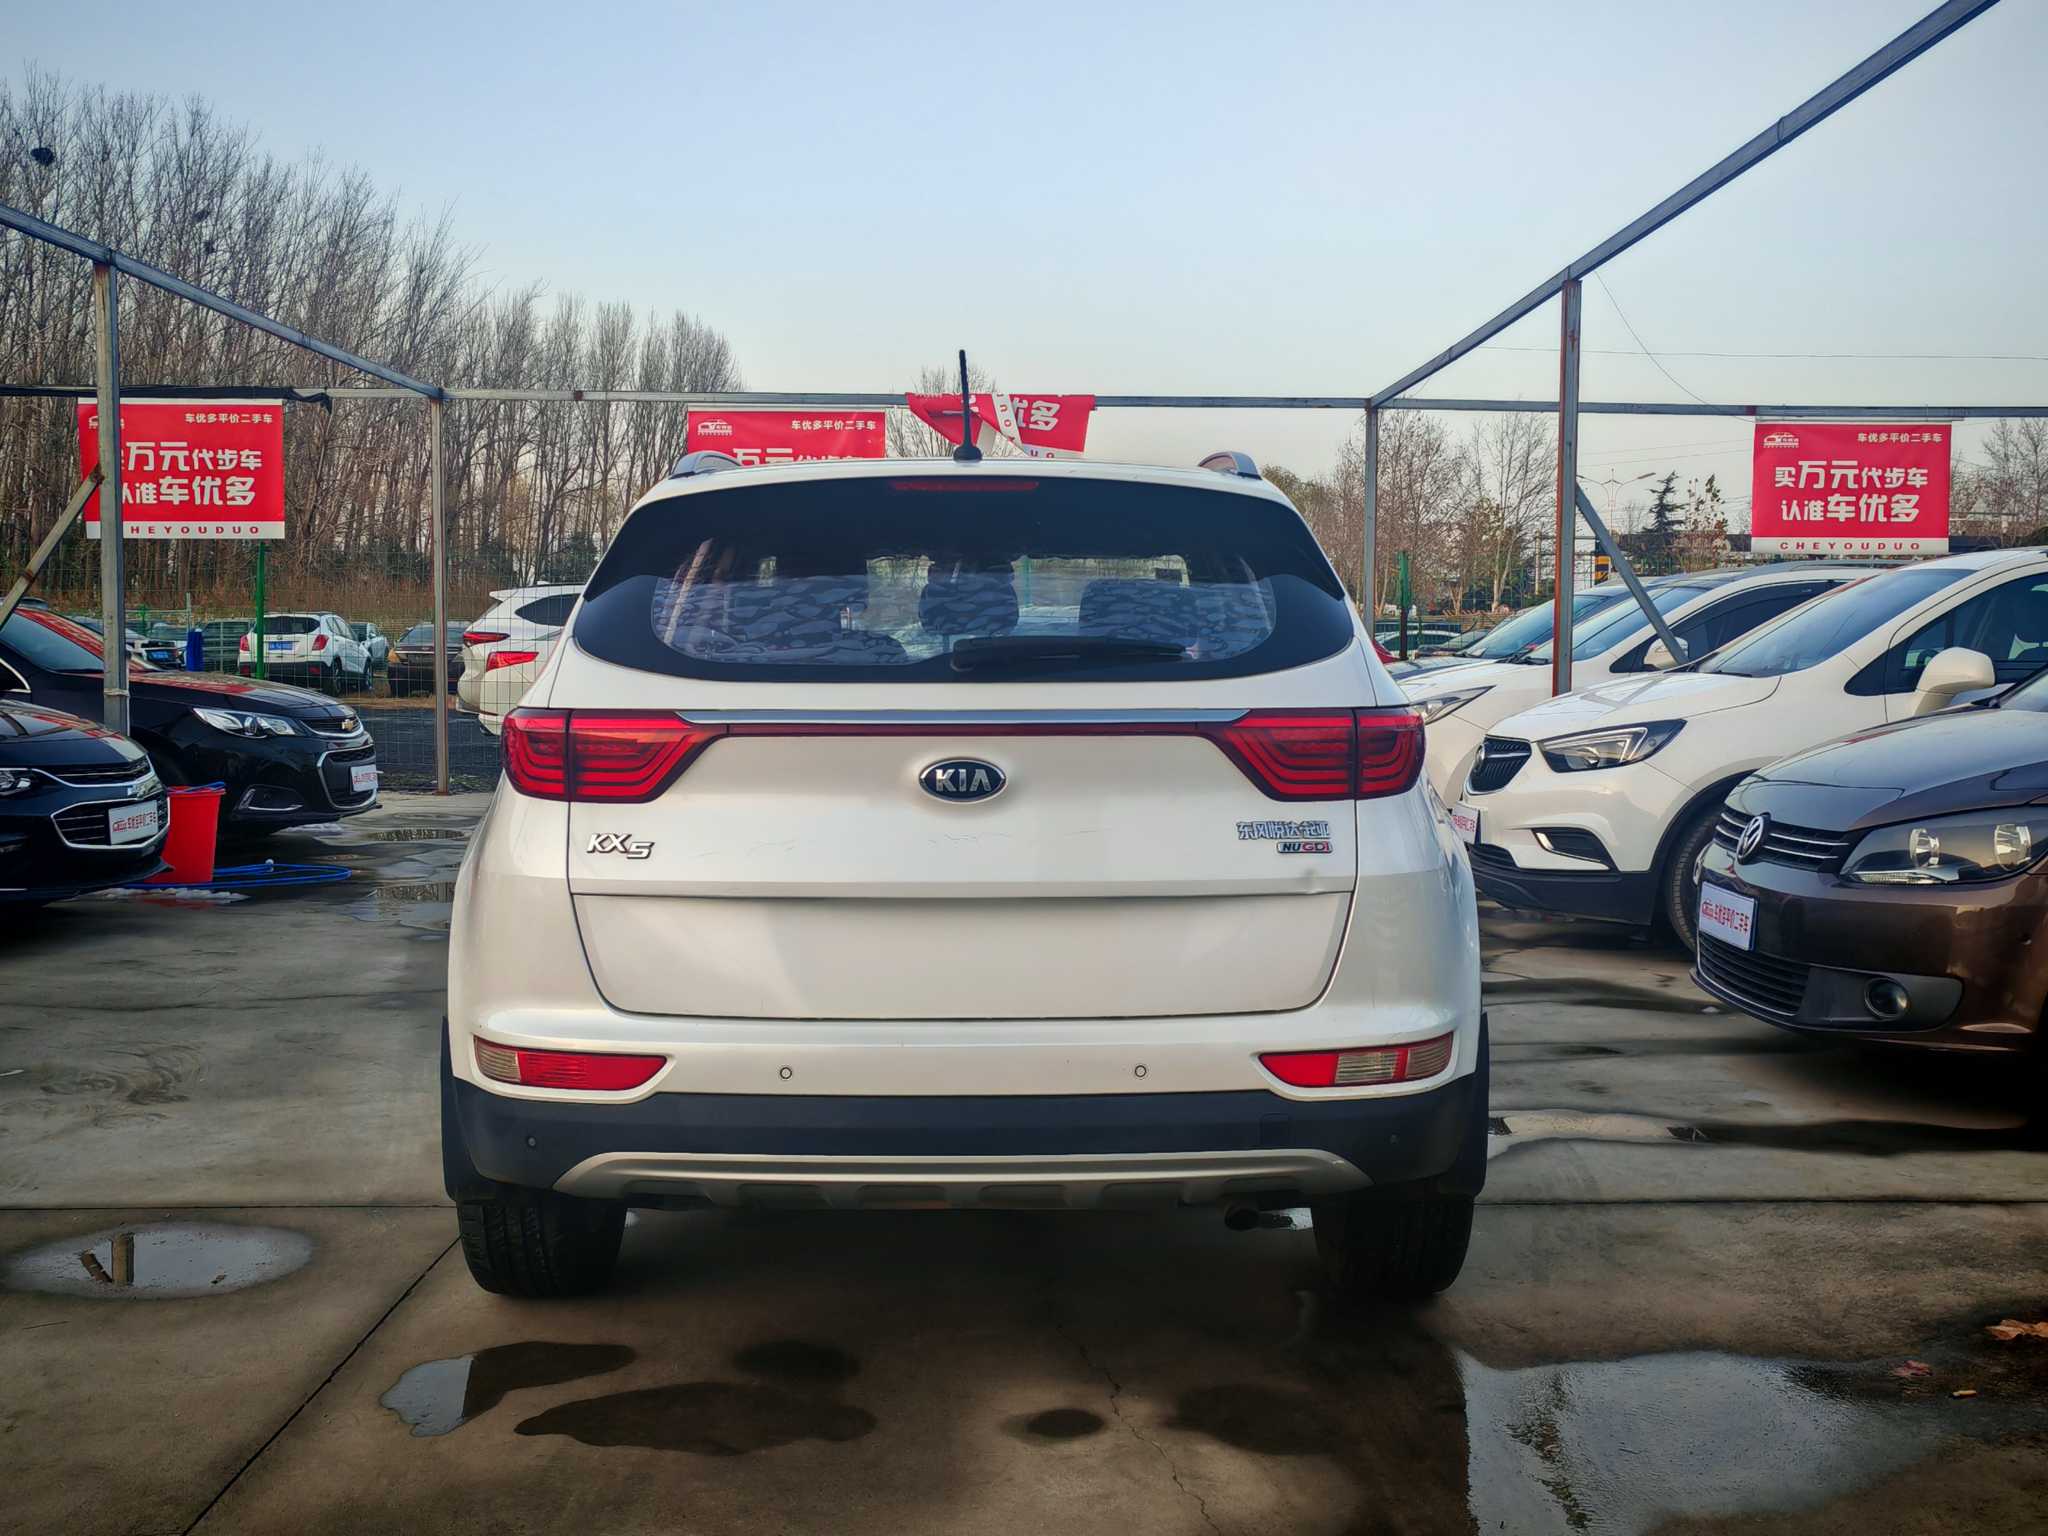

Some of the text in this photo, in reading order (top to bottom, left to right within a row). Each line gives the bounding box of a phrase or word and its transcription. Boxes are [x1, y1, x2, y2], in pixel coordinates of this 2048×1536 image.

[185, 413, 273, 424] 车优多平价二手车
[791, 420, 876, 431] 车优多平价二手车
[1857, 432, 1943, 443] 车优多平价二手车
[121, 441, 262, 472] 万元代步车
[1775, 460, 1929, 489] 买万元代步车
[1781, 493, 1920, 523] 认准车优多
[130, 525, 260, 534] HEYOUDUO
[1779, 542, 1920, 551] CHEYOUDUO
[934, 768, 993, 793] KIA
[586, 832, 656, 860] KX5
